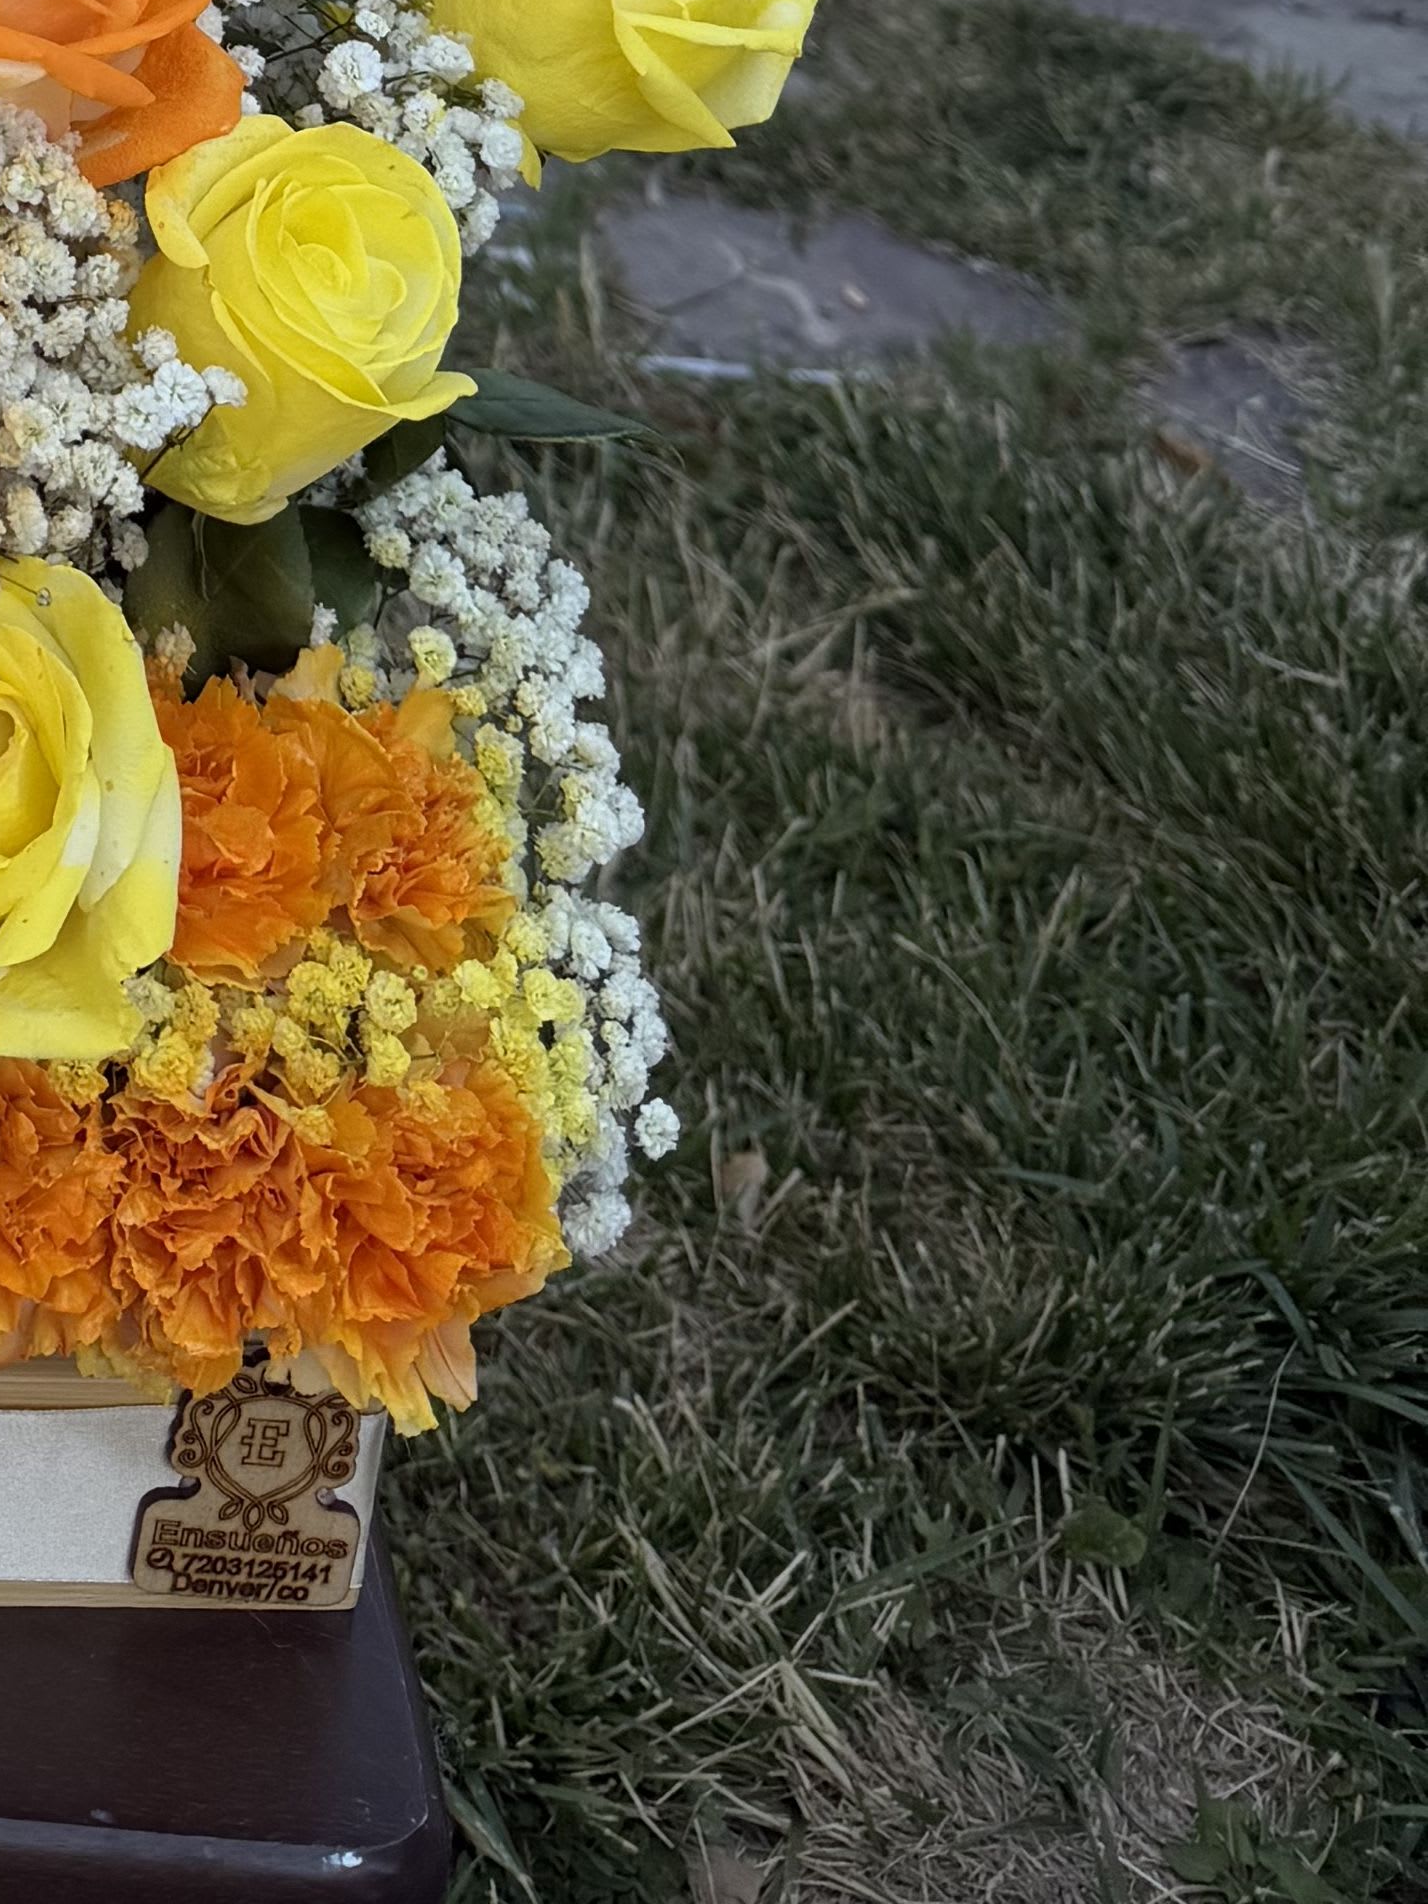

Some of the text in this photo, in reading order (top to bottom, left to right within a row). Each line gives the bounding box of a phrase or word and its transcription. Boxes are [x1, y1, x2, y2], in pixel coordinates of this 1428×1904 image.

[241, 1417, 290, 1467] E
[152, 1519, 348, 1559] Ensueños
[181, 1553, 332, 1585] 7203125141
